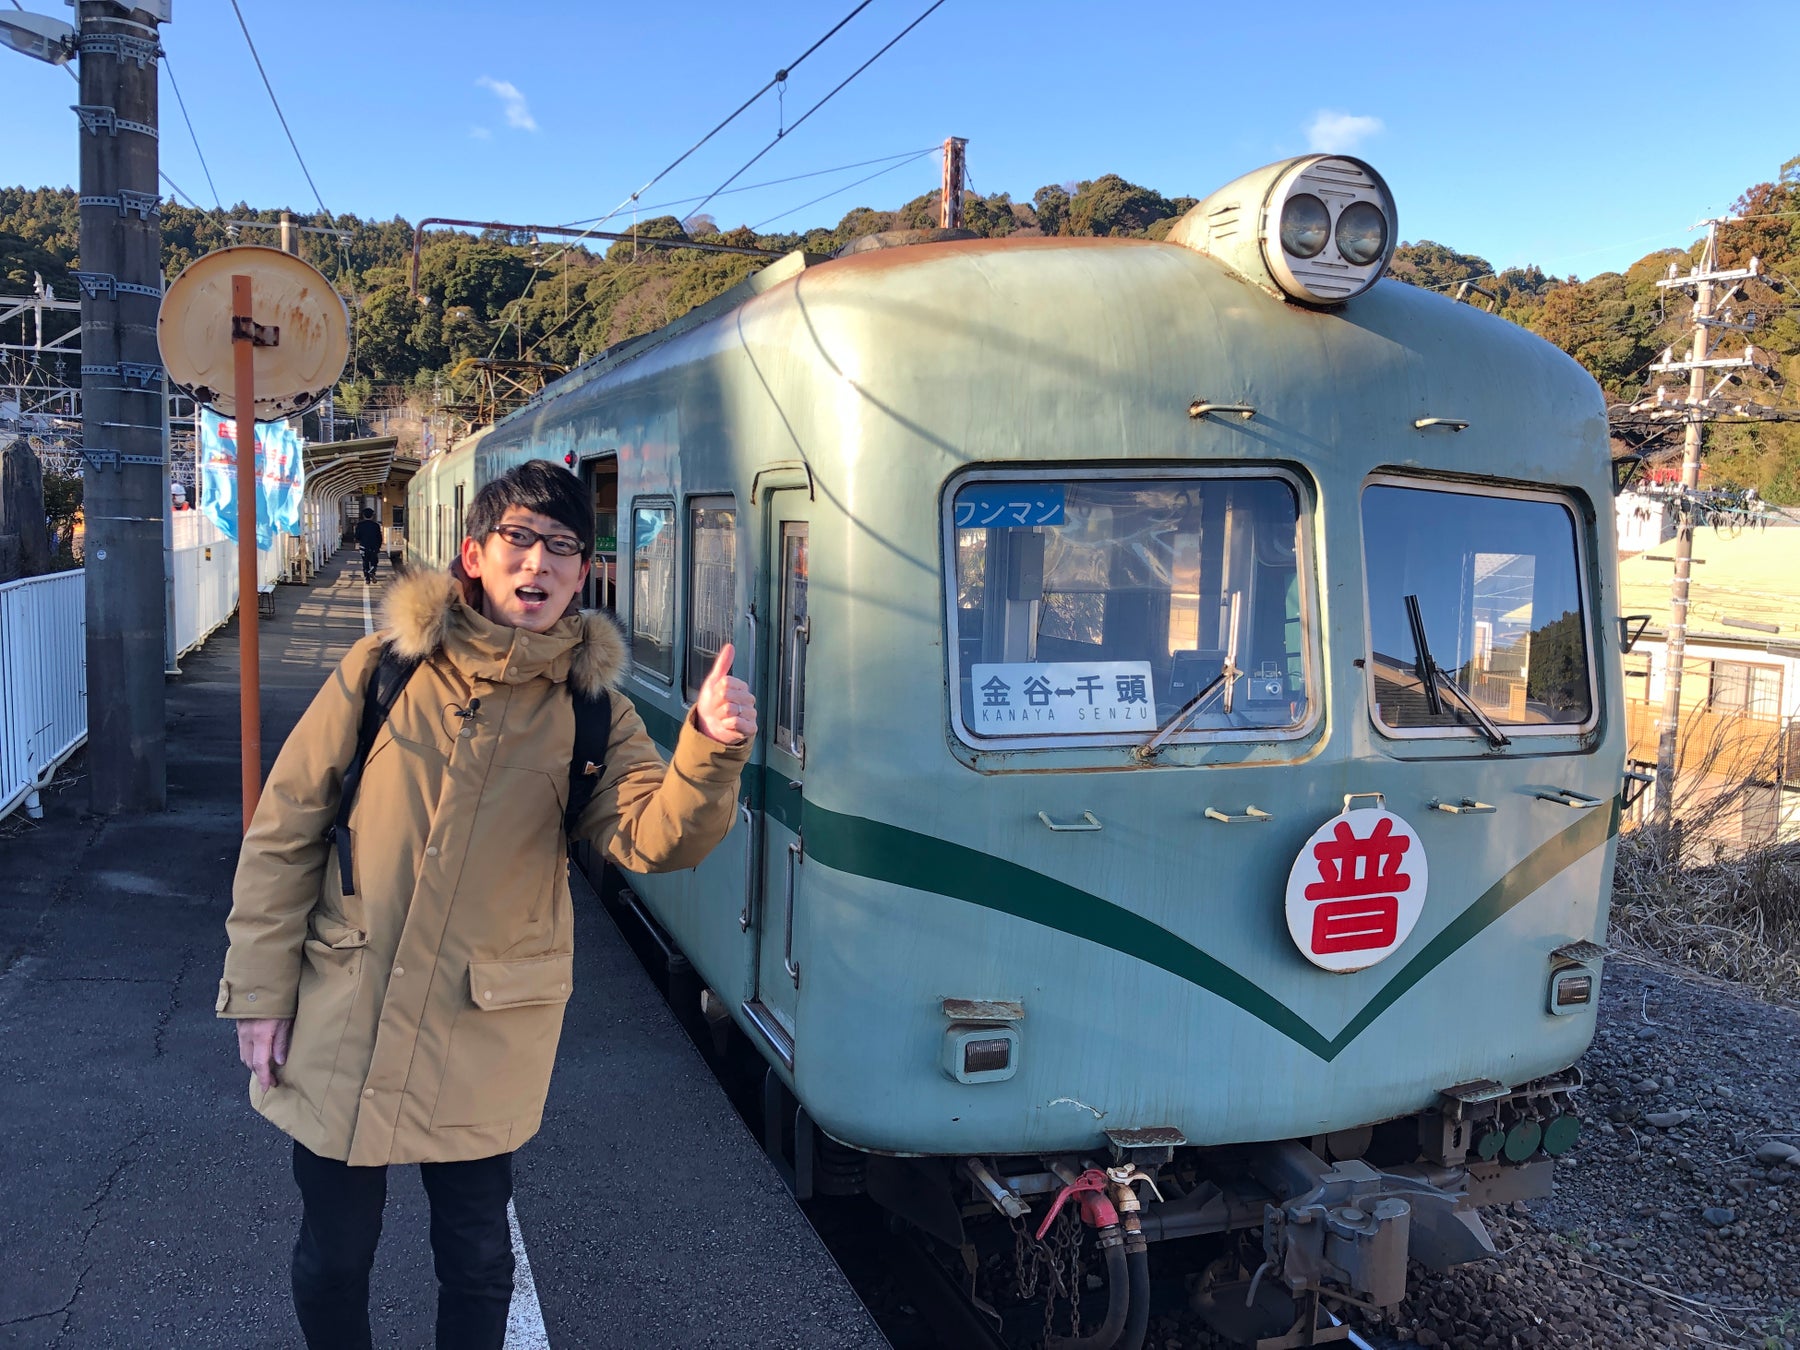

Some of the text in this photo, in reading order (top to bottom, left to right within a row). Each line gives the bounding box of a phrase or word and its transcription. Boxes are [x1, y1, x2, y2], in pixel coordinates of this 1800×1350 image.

[955, 501, 1061, 527] ワンマン
[980, 674, 1149, 707] 金谷 千頭
[982, 706, 1147, 722] KANAYA SENZU
[1304, 817, 1412, 955] 普
